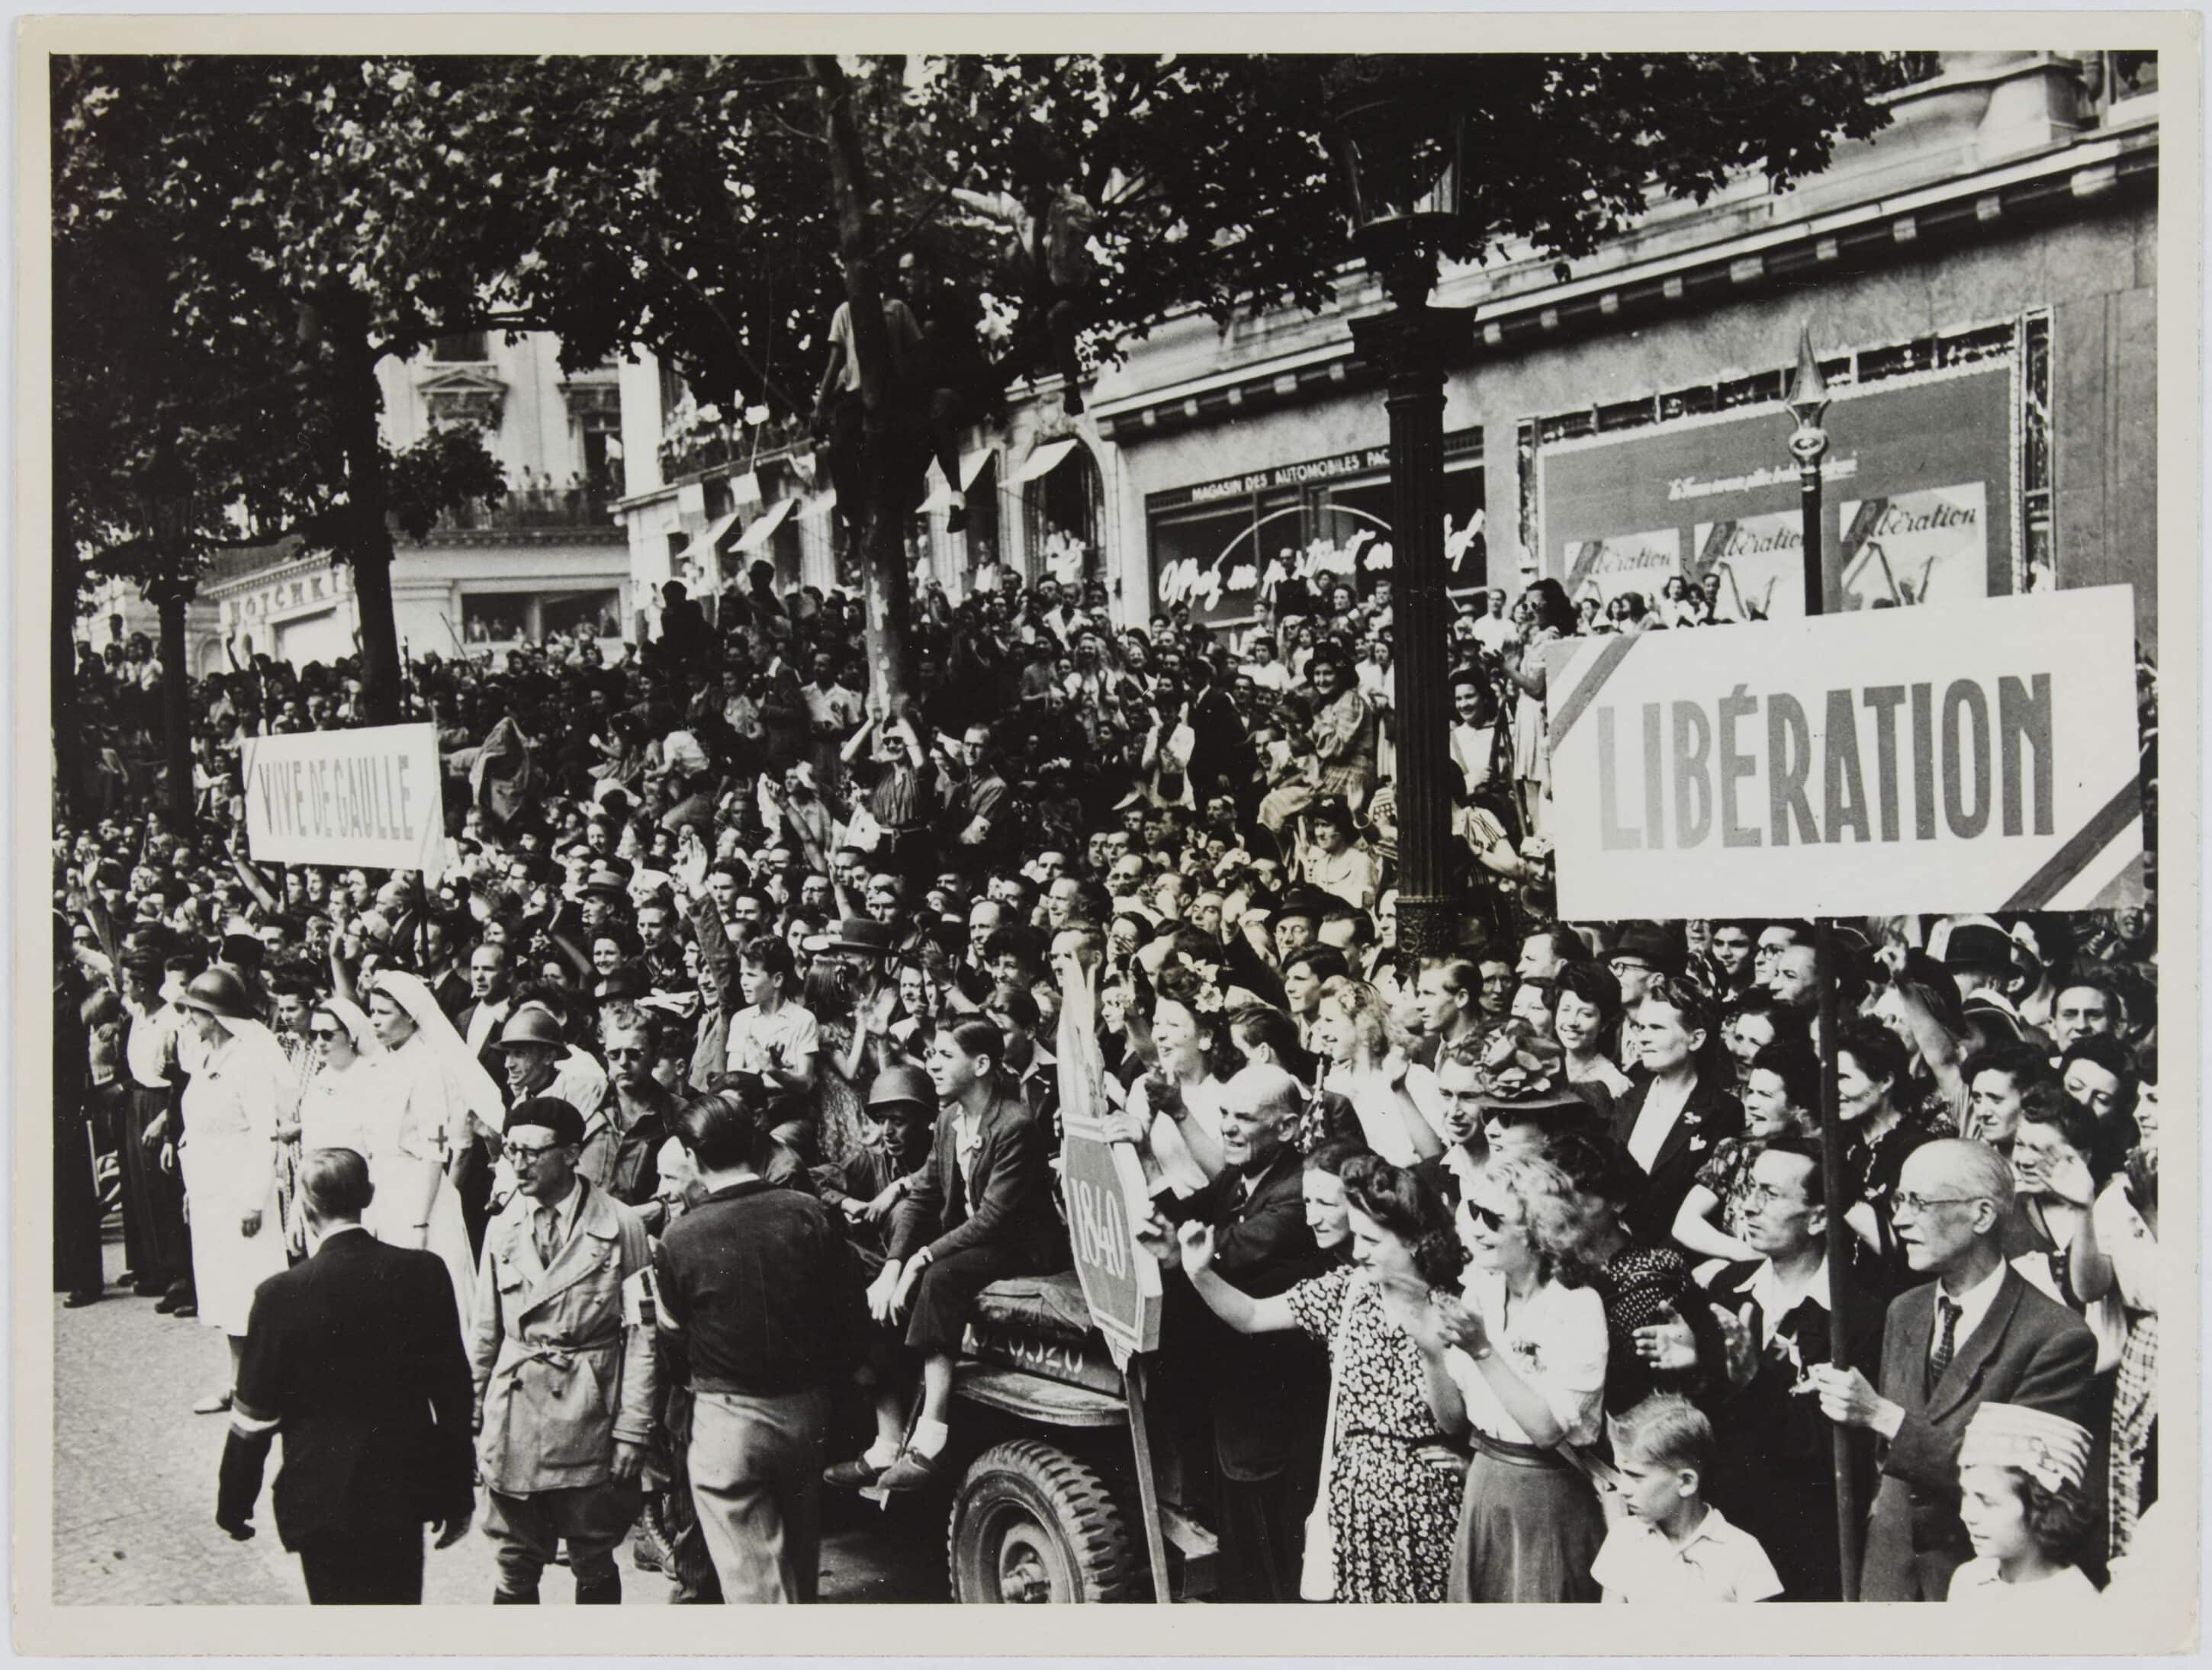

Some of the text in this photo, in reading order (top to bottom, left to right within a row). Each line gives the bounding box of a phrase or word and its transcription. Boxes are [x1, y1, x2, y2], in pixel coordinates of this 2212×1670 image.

[1191, 448, 1390, 502] MAGASIN DES AUTOMOBILES PAC
[1706, 522, 1801, 557] Libératio
[230, 570, 339, 625] HOTCHKI
[1596, 672, 2055, 851] LIBÉRATION
[258, 754, 415, 840] VIVE DE GAULLE
